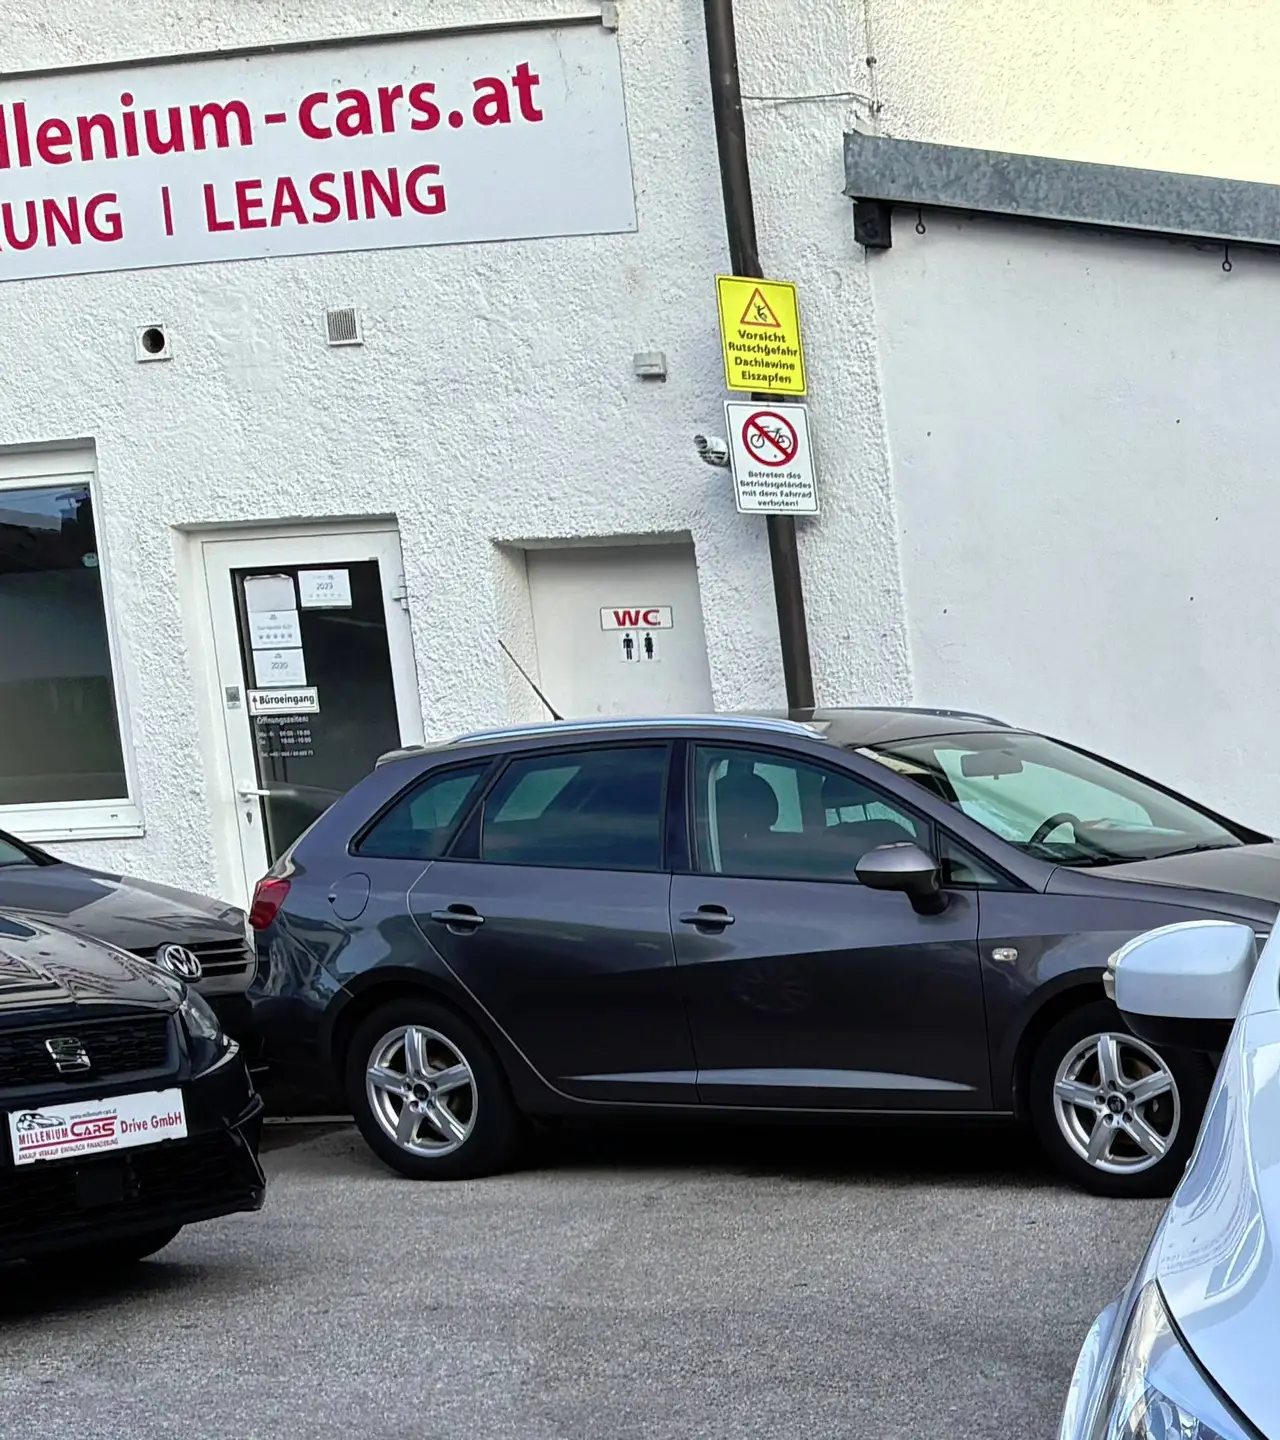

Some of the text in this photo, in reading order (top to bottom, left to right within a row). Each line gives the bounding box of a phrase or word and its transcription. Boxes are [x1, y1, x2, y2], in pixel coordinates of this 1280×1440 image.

[0, 193, 123, 251] UNG
[204, 164, 447, 233] LEASING
[738, 329, 786, 343] Vorsicht
[728, 342, 798, 357] Rutschgefahr
[735, 356, 795, 371] Dachlawine
[742, 370, 792, 387] Eiszapfen
[259, 693, 315, 705] Büroeingang
[19, 1115, 118, 1145] MILLENIUM CARS
[121, 1112, 182, 1134] Drive GmbH
